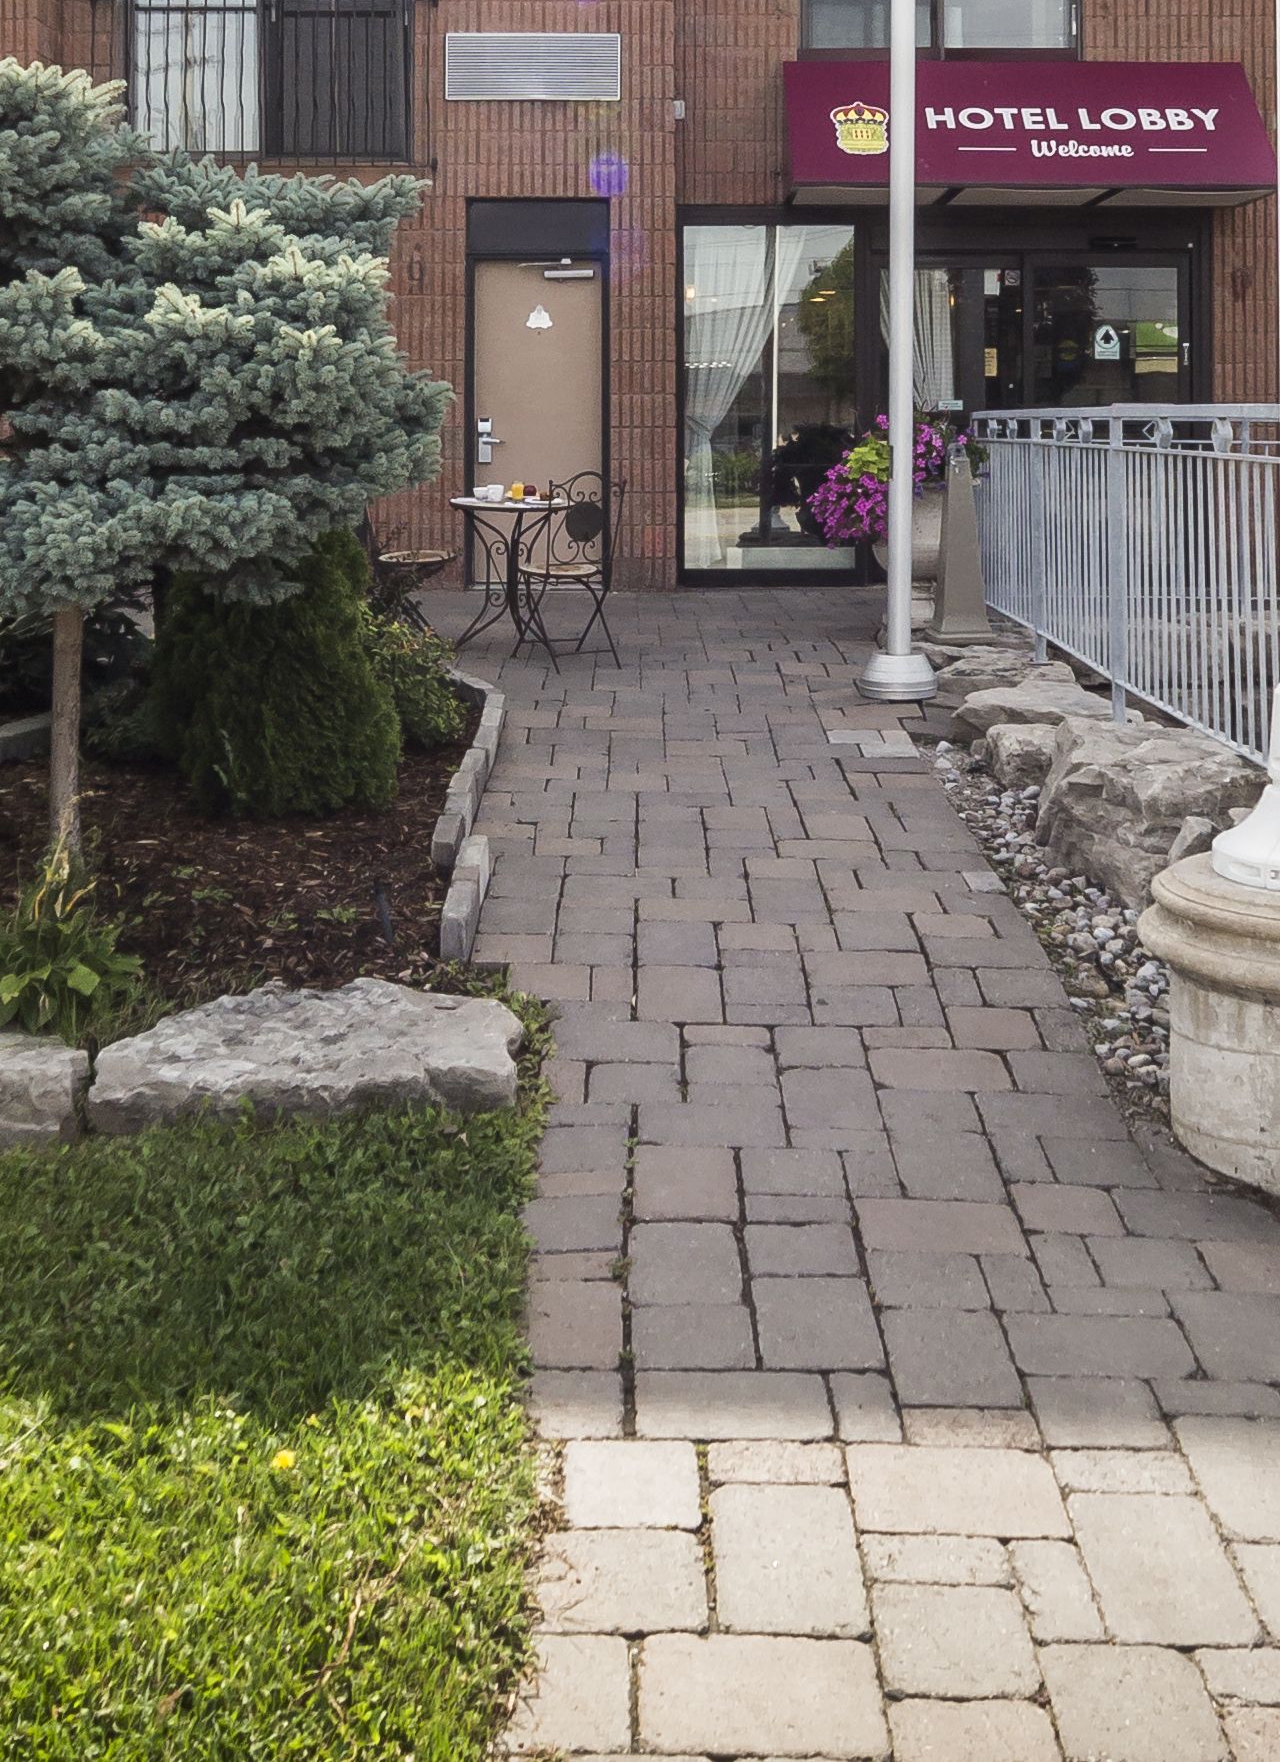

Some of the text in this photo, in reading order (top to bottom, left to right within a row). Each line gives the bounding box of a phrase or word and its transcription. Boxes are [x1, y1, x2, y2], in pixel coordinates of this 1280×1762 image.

[925, 105, 1220, 132] HOTEL LOBBY
[1030, 139, 1135, 159] Welcome
